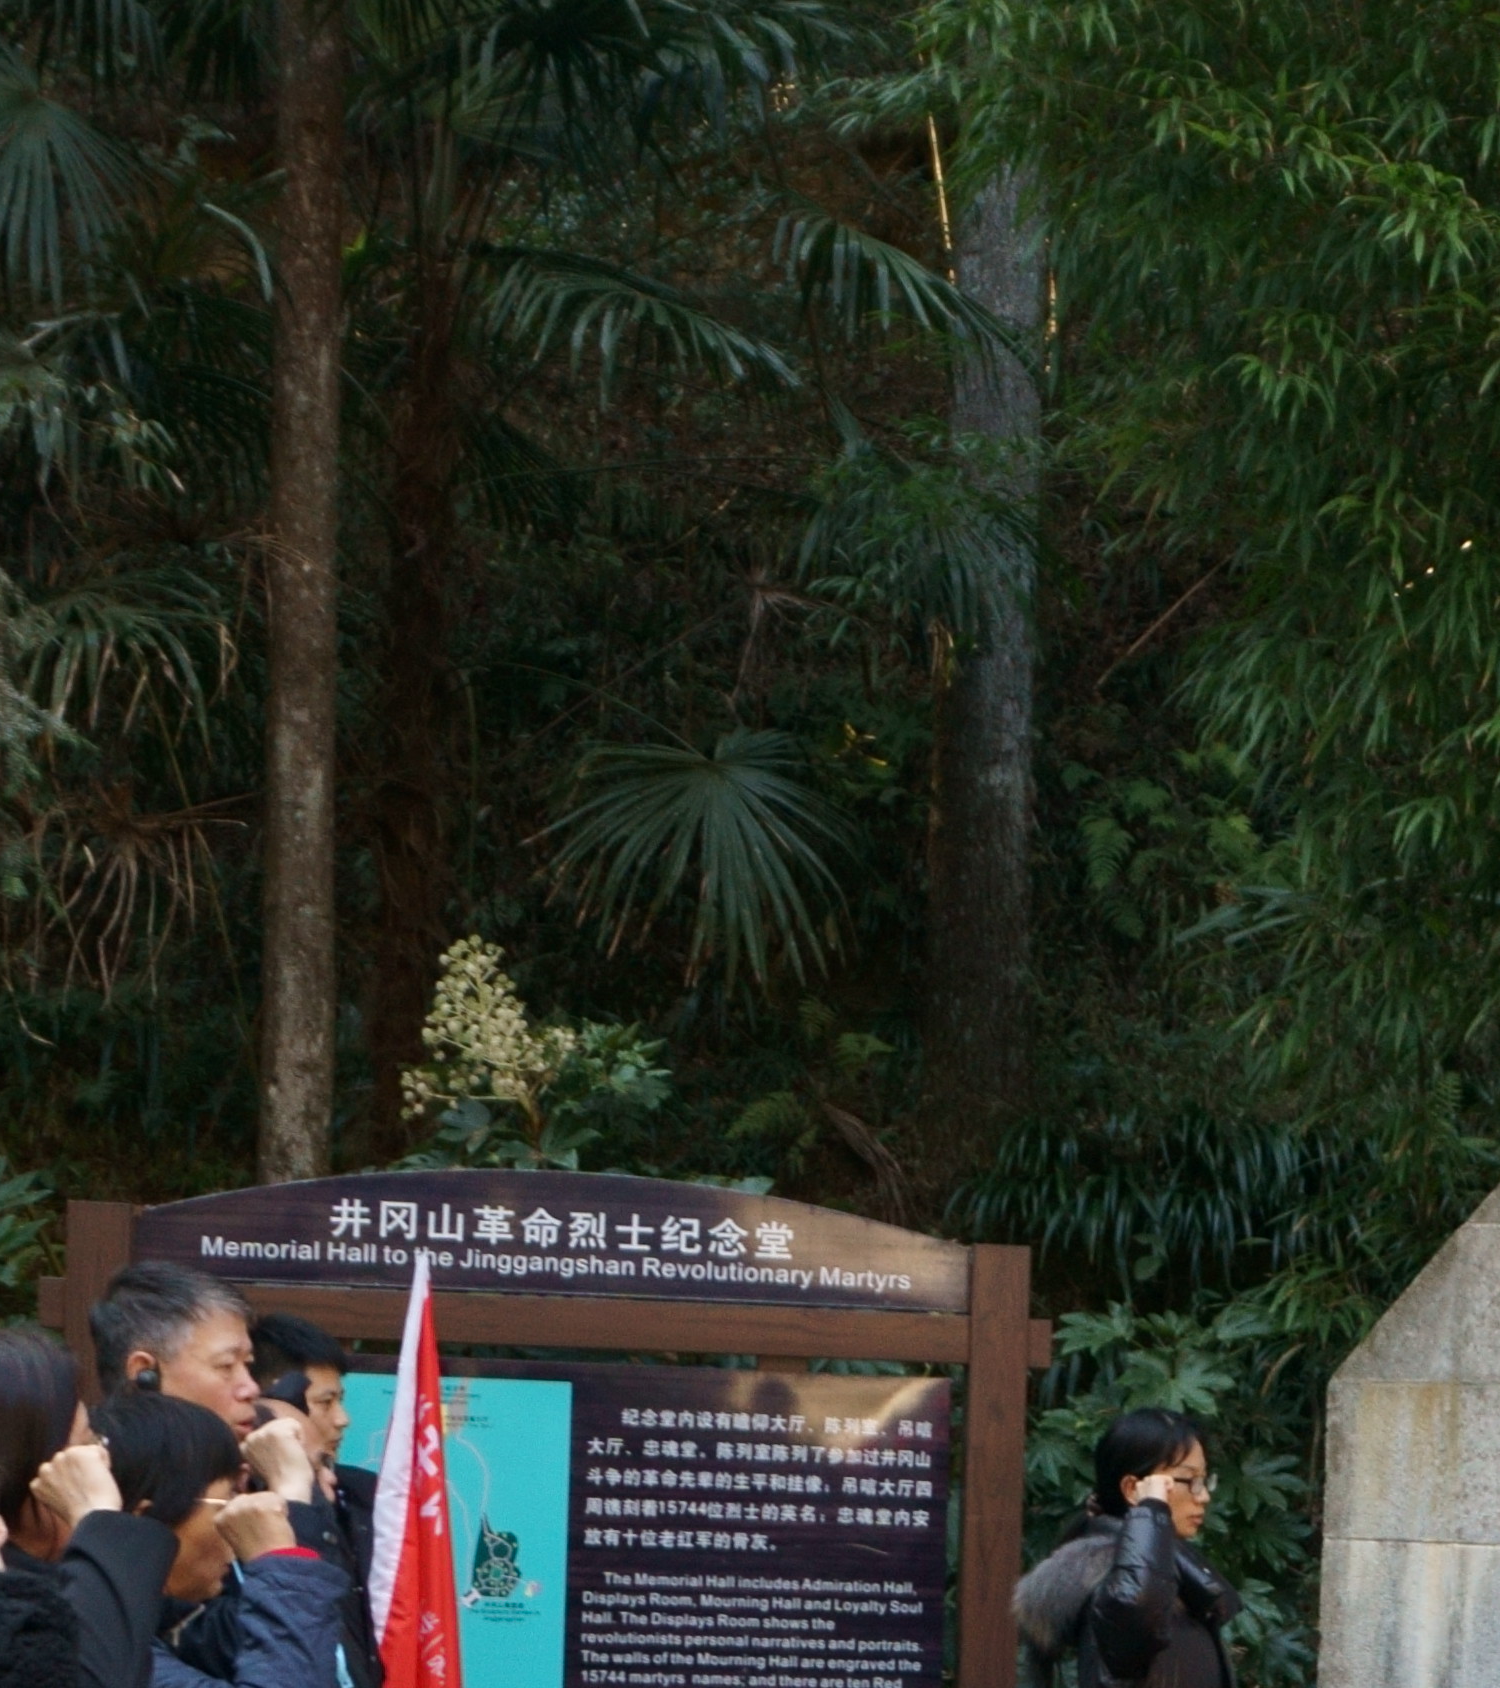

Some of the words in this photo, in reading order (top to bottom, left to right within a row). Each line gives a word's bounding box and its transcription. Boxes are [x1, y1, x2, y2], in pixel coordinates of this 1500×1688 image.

[330, 1197, 794, 1260] 井冈山革命烈士纪念堂
[200, 1235, 321, 1262] Memorial
[327, 1241, 377, 1264] Hall
[383, 1246, 409, 1265] to
[460, 1250, 635, 1277] Jinggangshan
[641, 1257, 813, 1289] Revolutionary
[818, 1266, 912, 1292] Martyrs
[603, 1572, 632, 1585] The
[634, 1573, 703, 1587] Memorial
[706, 1575, 735, 1588] Hall
[738, 1576, 799, 1590] includes
[802, 1578, 880, 1593] Admiration
[582, 1591, 646, 1607] Displays
[700, 1594, 769, 1611] Mourning
[772, 1597, 801, 1609] Hall
[804, 1599, 831, 1611] and
[834, 1599, 887, 1615] Loyalty
[890, 1600, 923, 1614] Soul
[620, 1612, 647, 1625] The
[651, 1612, 714, 1628] Displays
[717, 1614, 760, 1628] Room
[763, 1616, 809, 1629] shows
[811, 1617, 836, 1630] the
[580, 1632, 682, 1646] revolutionists
[684, 1634, 749, 1648] personal
[751, 1636, 825, 1649] narratives
[828, 1638, 855, 1650] and
[581, 1650, 609, 1663] The
[612, 1651, 650, 1664] walls
[653, 1652, 668, 1664] of
[670, 1653, 694, 1665] the
[697, 1652, 766, 1669] Mourning
[769, 1655, 798, 1668] Hall
[800, 1657, 825, 1669] are
[827, 1657, 895, 1672] engraved
[898, 1659, 922, 1672] the
[581, 1670, 626, 1683] 15744
[628, 1672, 685, 1686] martyrs
[749, 1674, 776, 1687] and
[779, 1675, 817, 1687] there
[820, 1677, 844, 1688] are
[847, 1677, 870, 1688] ten
